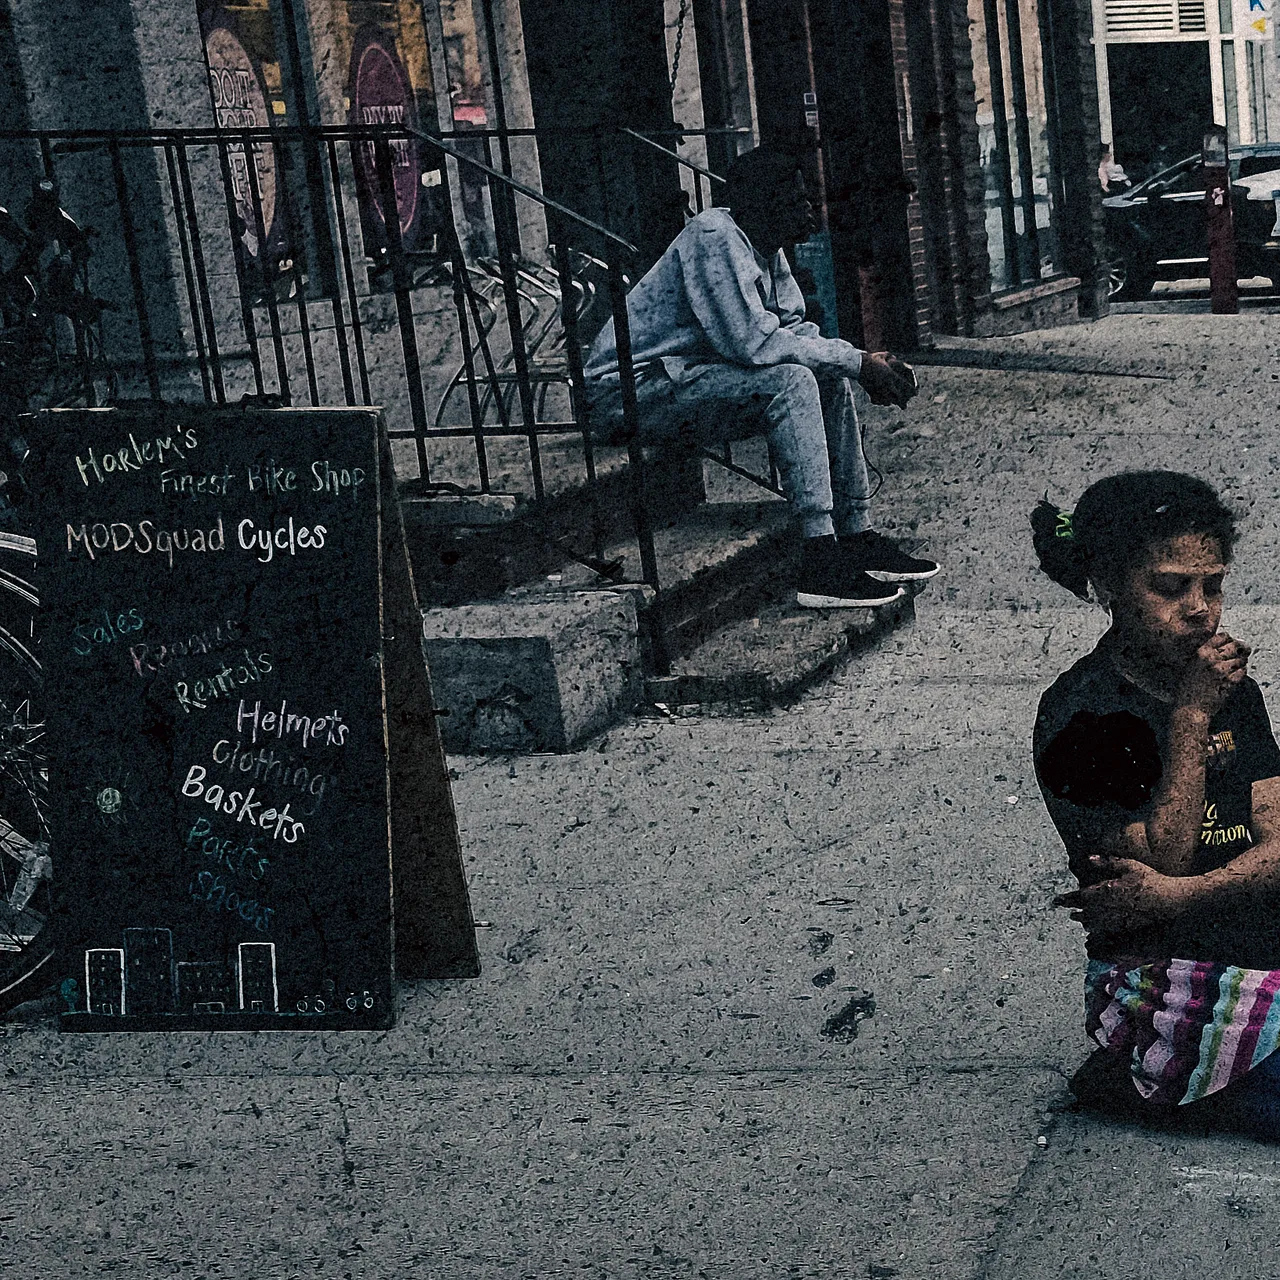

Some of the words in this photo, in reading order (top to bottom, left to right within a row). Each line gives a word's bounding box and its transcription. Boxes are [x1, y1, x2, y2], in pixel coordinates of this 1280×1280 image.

[161, 464, 236, 497] Finest
[247, 460, 298, 496] Bike
[311, 461, 366, 502] Shop
[238, 516, 328, 563] Cycles
[73, 607, 144, 656] Sales
[173, 649, 274, 713] Rentals
[237, 699, 350, 749] Helmets
[181, 764, 307, 844] Baskets
[212, 738, 326, 816] Clothing
[186, 817, 270, 881] Parts
